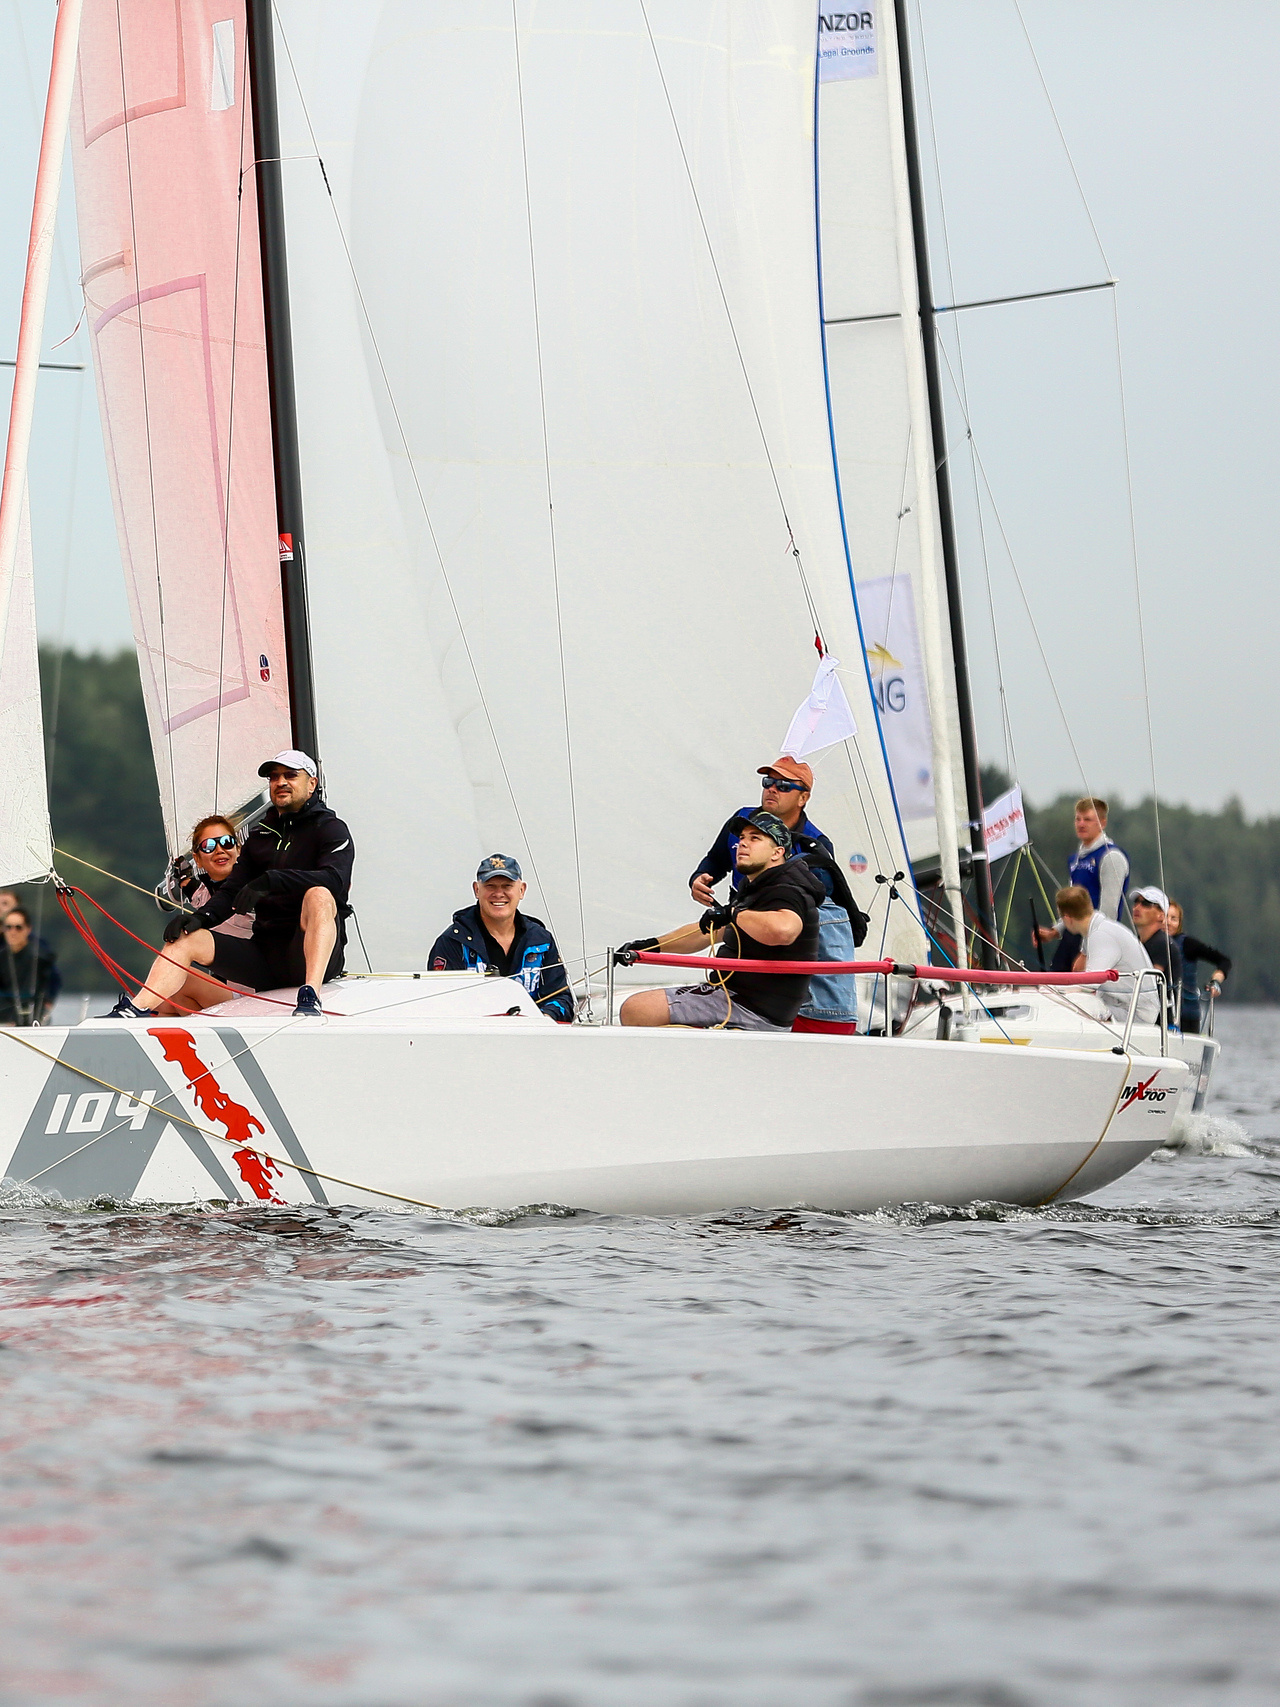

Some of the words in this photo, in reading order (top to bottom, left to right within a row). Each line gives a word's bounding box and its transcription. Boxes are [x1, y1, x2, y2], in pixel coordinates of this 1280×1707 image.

[820, 11, 873, 33] NZOR
[841, 46, 874, 56] Grounds
[45, 1090, 156, 1135] 104
